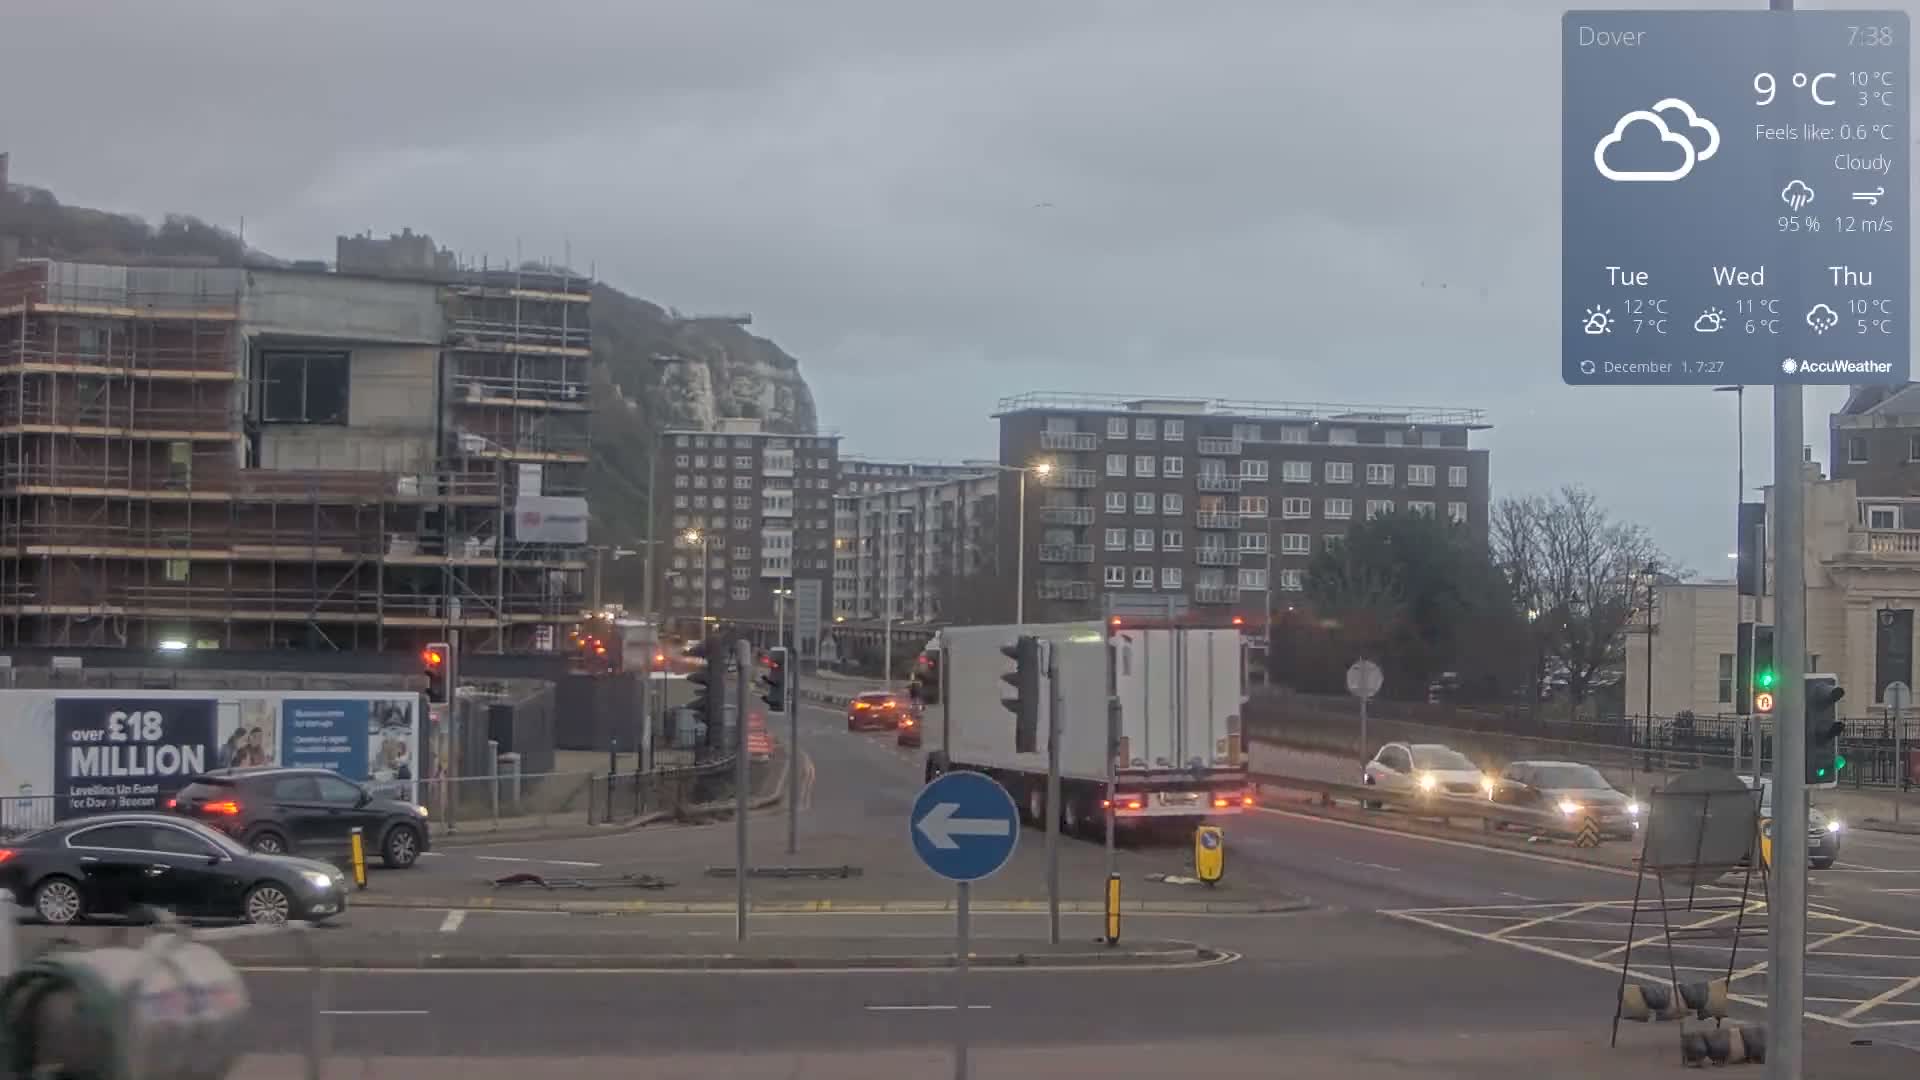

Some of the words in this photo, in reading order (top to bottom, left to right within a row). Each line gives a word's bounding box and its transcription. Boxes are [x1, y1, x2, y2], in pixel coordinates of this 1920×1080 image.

[71, 727, 105, 741] over
[109, 710, 163, 741] £18
[70, 744, 205, 777] MILLION
